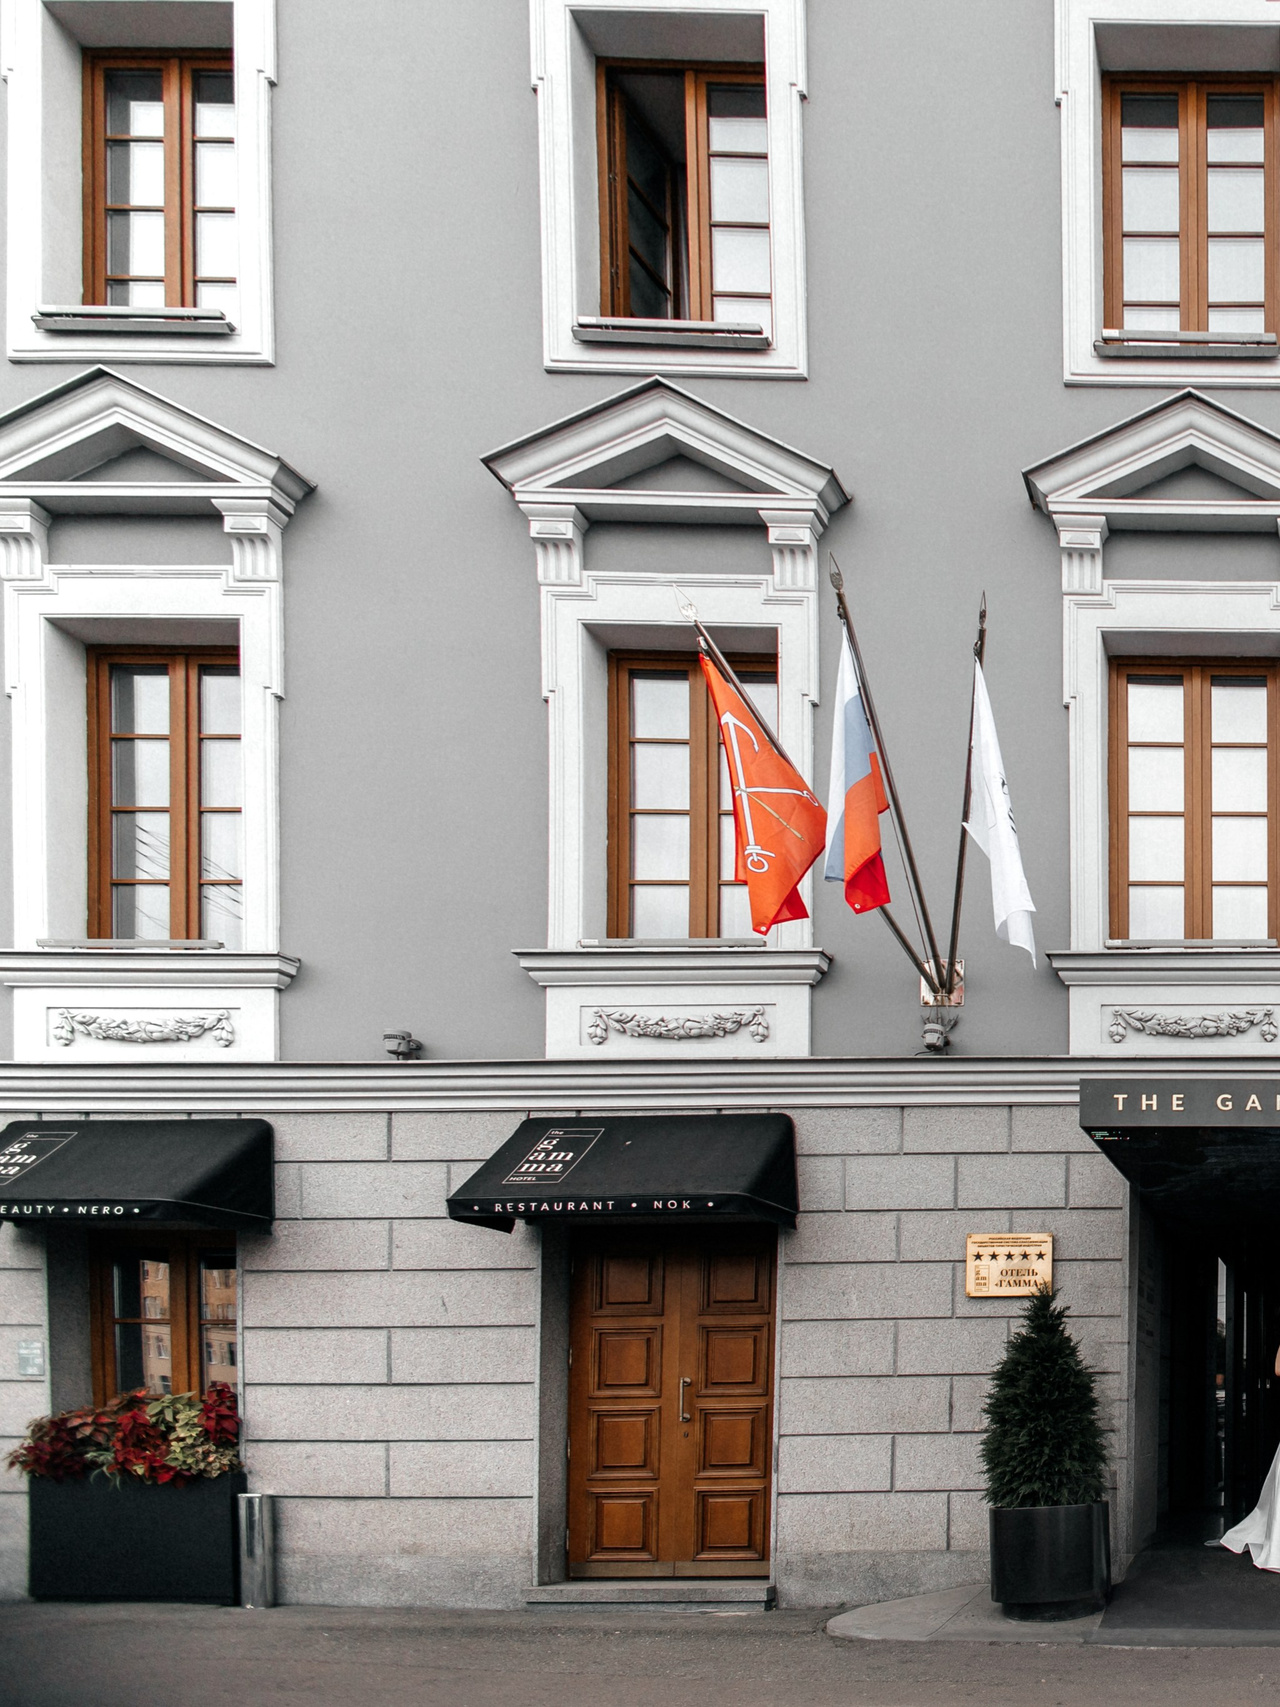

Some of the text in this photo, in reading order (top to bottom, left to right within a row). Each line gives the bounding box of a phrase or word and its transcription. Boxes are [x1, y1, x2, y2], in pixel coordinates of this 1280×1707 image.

[1113, 1094, 1185, 1111] THE
[536, 1138, 560, 1151] g
[528, 1151, 574, 1161] am
[517, 1163, 563, 1172] ma
[77, 1205, 124, 1215] NERO
[494, 1199, 691, 1212] RESTAURANT NOK
[1000, 1268, 1038, 1277] ОТЕЛЬ
